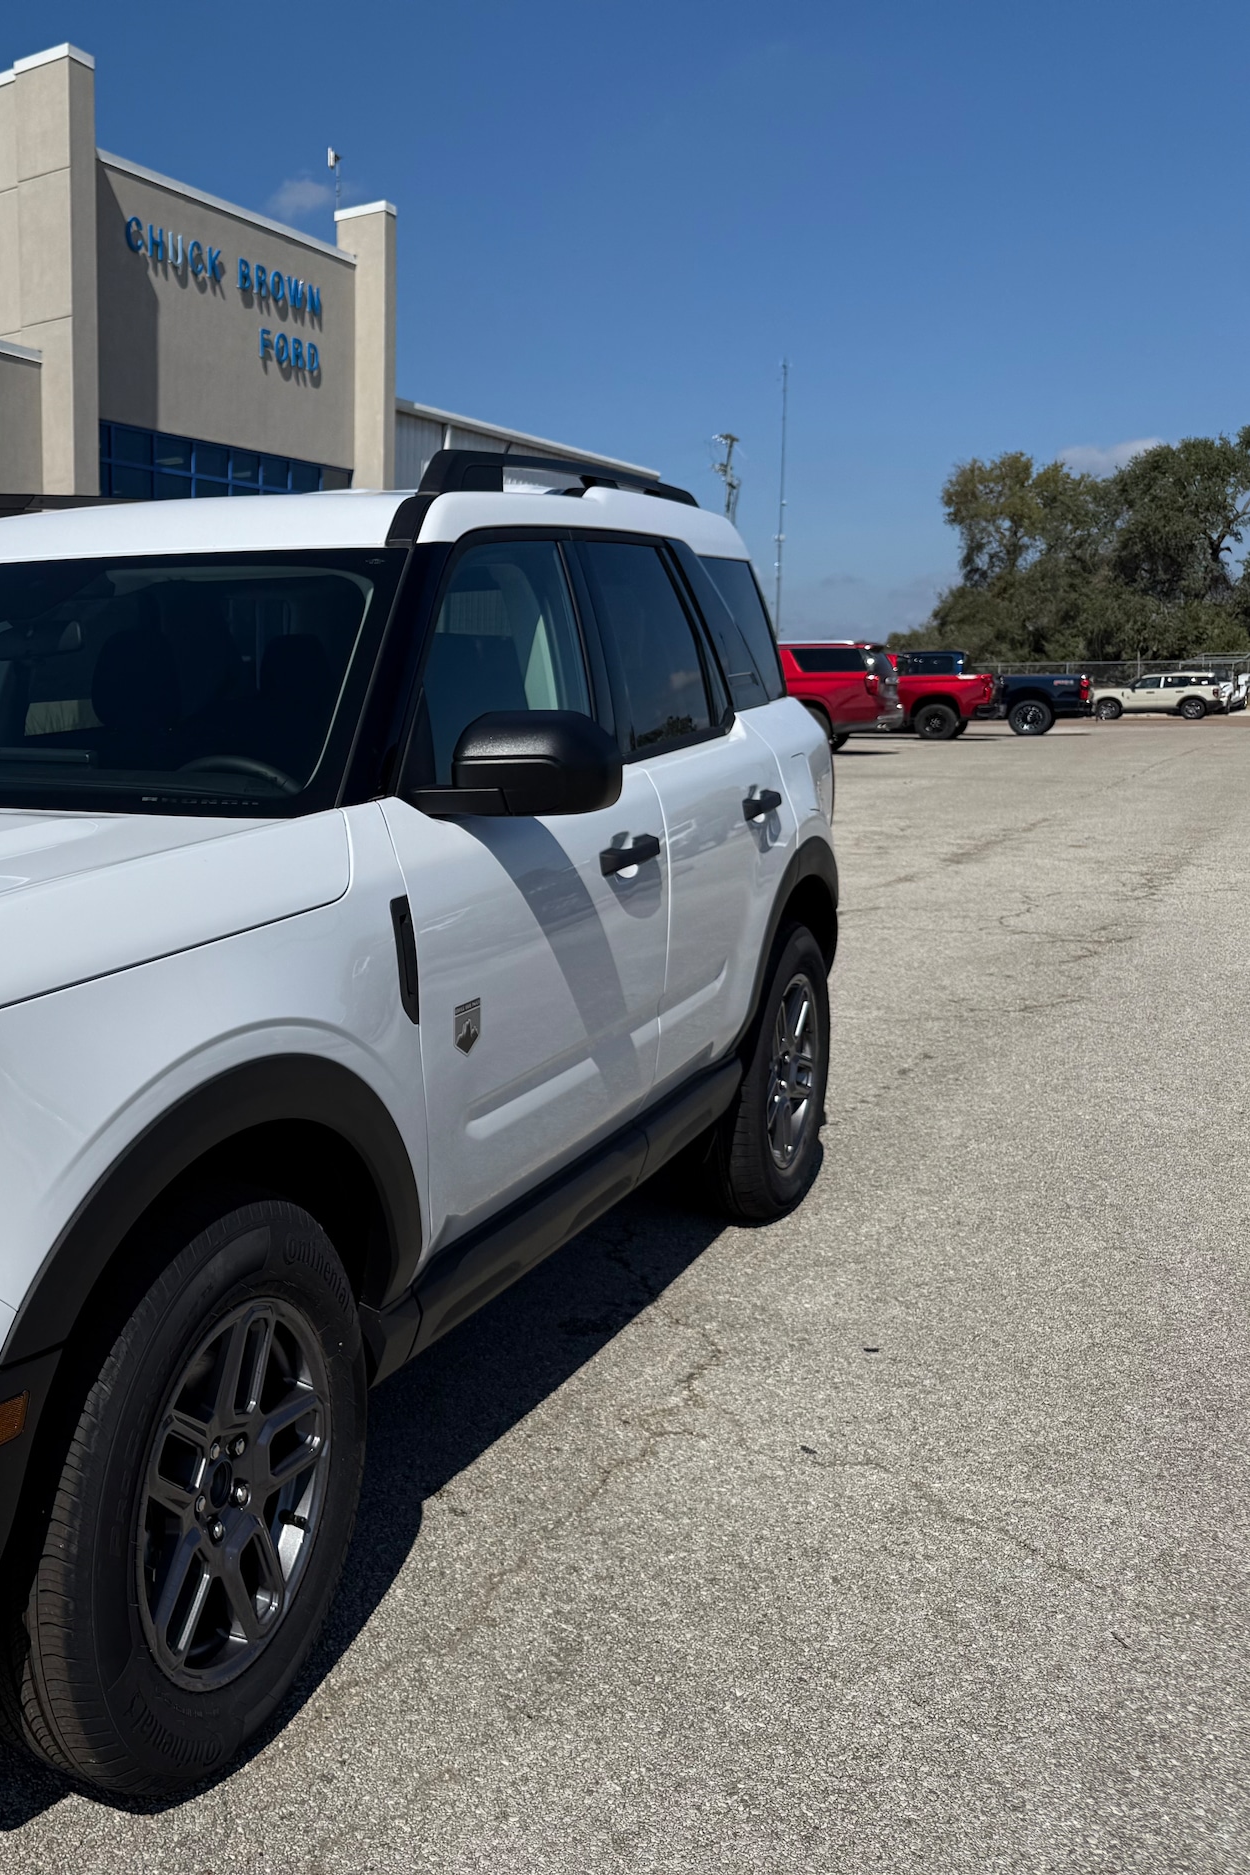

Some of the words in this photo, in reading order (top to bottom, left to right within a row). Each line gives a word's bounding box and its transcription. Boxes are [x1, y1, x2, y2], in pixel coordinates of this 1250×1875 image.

[125, 216, 221, 283] CHUCK
[237, 257, 321, 316] BROWN
[258, 328, 320, 373] FORD
[282, 1231, 351, 1314] Continental
[130, 1703, 223, 1768] Continental
